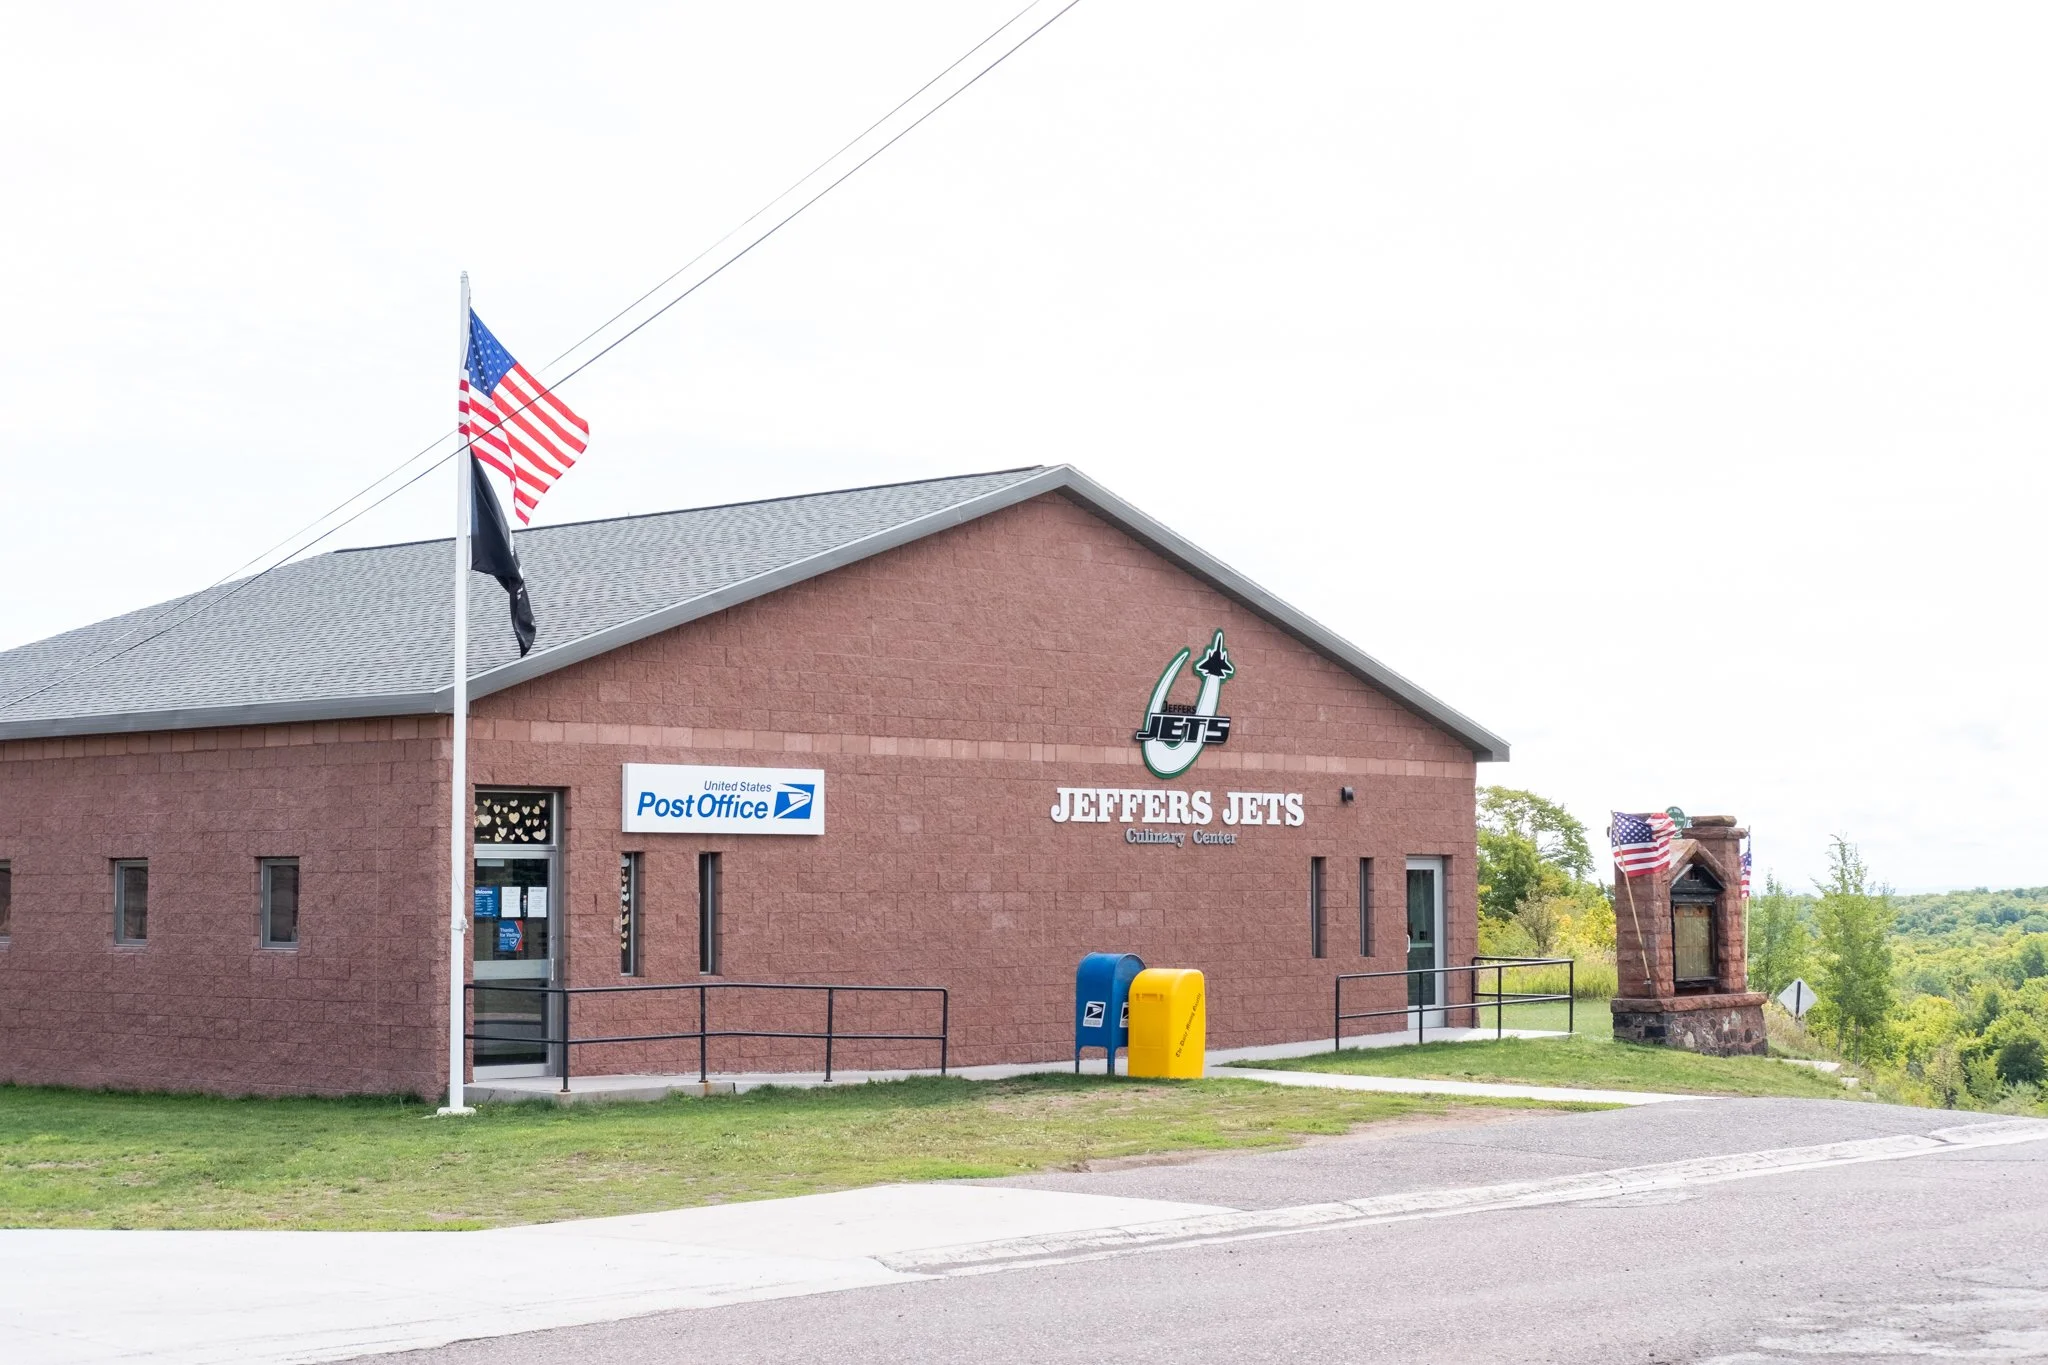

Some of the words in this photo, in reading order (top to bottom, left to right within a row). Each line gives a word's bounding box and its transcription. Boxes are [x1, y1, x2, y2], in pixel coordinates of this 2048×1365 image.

[1162, 701, 1197, 714] JEFFERS
[1136, 713, 1231, 744] JETS
[704, 780, 738, 792] United
[739, 782, 772, 792] States
[637, 791, 694, 818] Post
[697, 793, 769, 820] Office
[1051, 787, 1213, 825] JEFFERS
[1222, 791, 1305, 826] JETS
[1125, 827, 1186, 848] Culinary
[1192, 829, 1237, 845] Center
